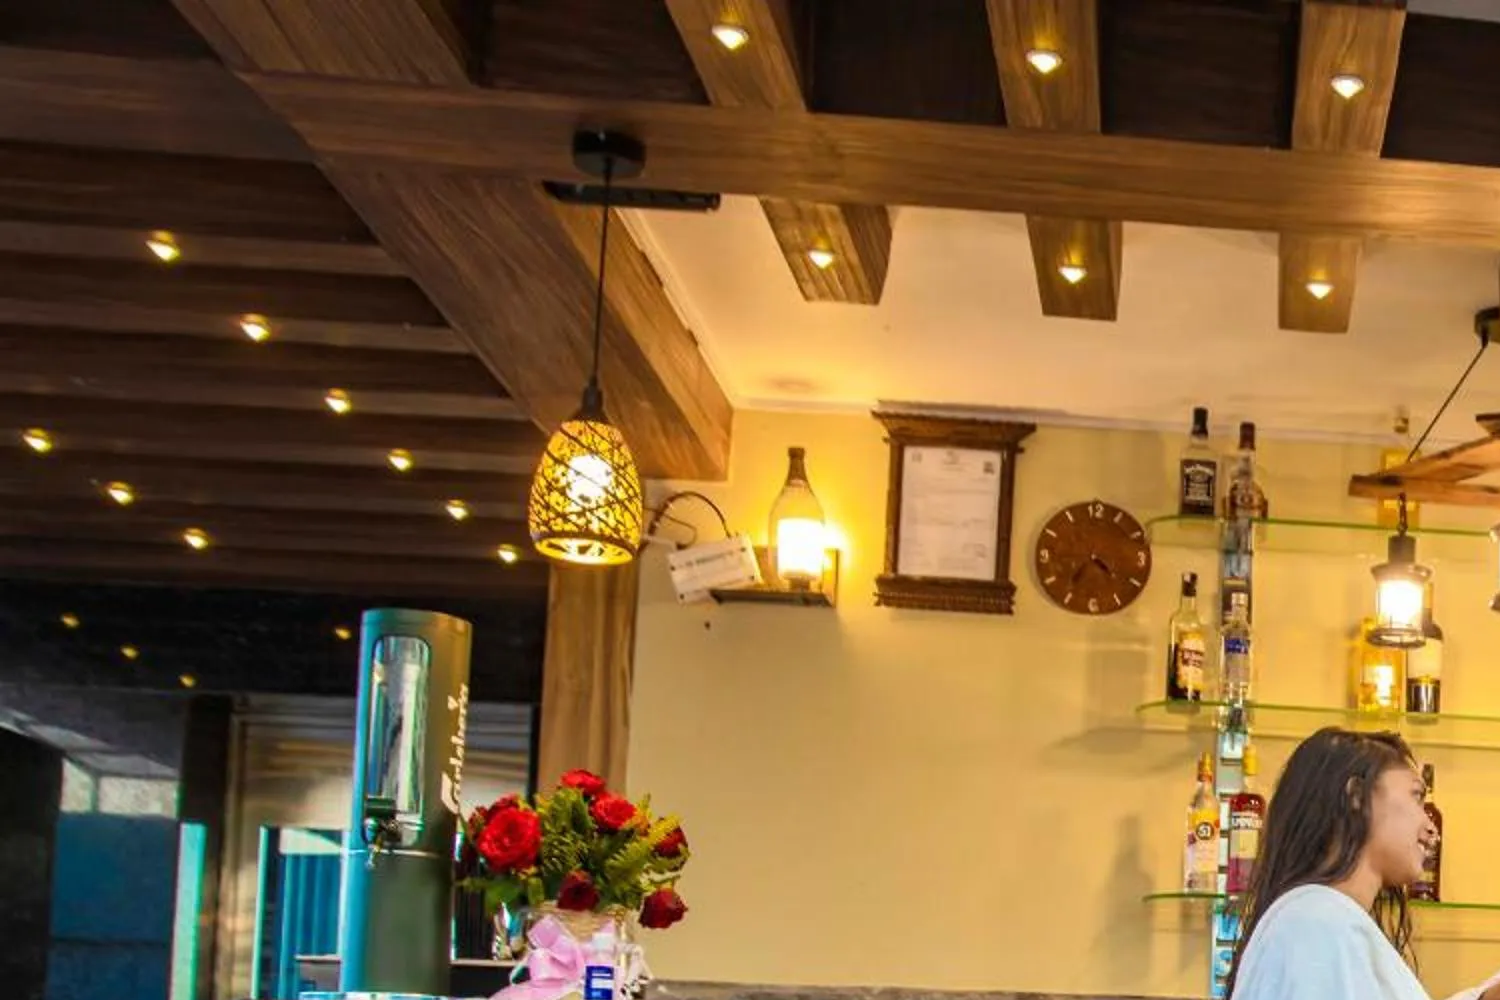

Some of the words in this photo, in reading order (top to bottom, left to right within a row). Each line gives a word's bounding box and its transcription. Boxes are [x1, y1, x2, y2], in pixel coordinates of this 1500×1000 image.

[1087, 503, 1105, 519] 12
[1039, 548, 1050, 563] 9
[1136, 551, 1147, 567] 3
[1086, 598, 1099, 612] 6
